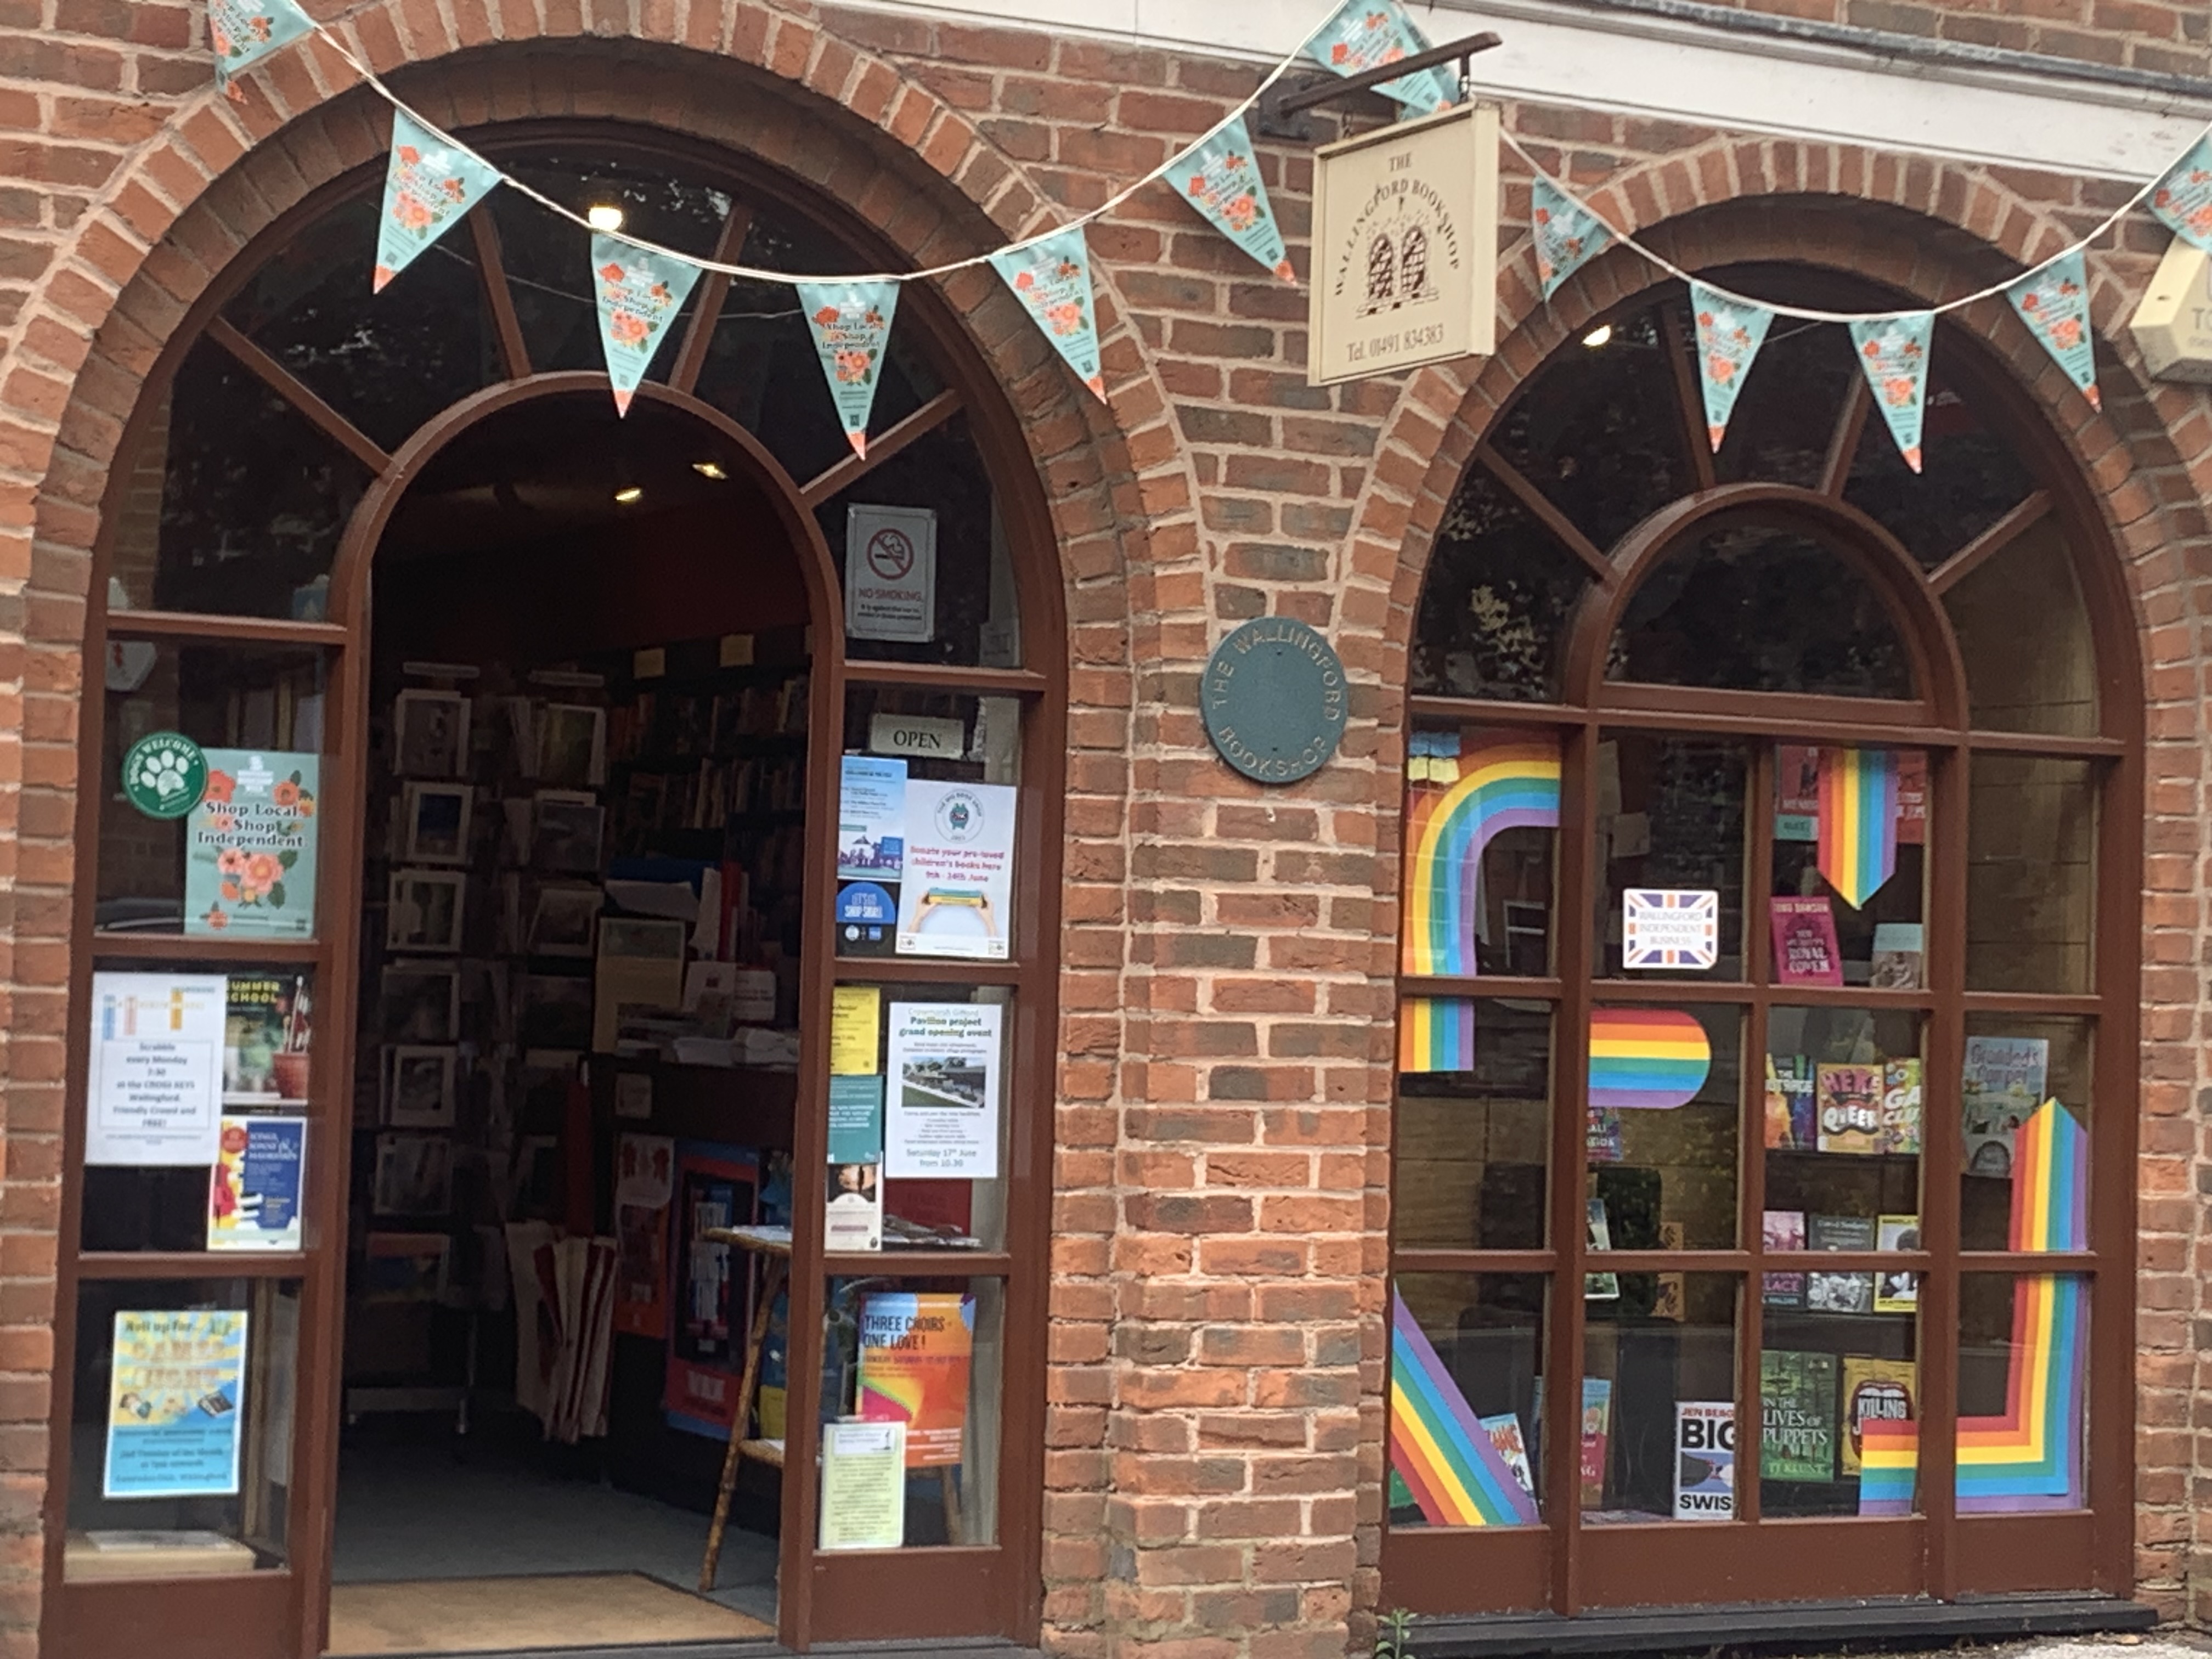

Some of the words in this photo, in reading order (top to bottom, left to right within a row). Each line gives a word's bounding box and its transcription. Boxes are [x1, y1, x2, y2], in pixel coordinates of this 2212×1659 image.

[1389, 153, 1412, 172] THE
[1335, 178, 1409, 296] WALLINGFORD
[1412, 179, 1459, 269] BOOKSHOP
[1369, 333, 1399, 358] 01491
[859, 588, 873, 599] NO
[875, 589, 922, 601] SMOKING
[1212, 661, 1234, 709] THE
[1233, 624, 1341, 721] WALLINGFORD
[893, 730, 943, 749] OPEN
[142, 738, 196, 760] WELCOME
[1218, 726, 1326, 777] BOOKSHOP
[206, 802, 249, 817] Shop
[256, 803, 297, 816] Local
[234, 819, 275, 833] Shop
[198, 831, 303, 847] Independent
[942, 849, 961, 857] your
[1639, 911, 1703, 922] WALLINGFORD
[1639, 923, 1702, 933] INDEPENDENT
[1650, 936, 1691, 945] BUSINESS
[949, 1018, 981, 1028] project
[899, 1027, 926, 1037] grand
[928, 1029, 964, 1038] opening
[967, 1029, 992, 1037] event
[152, 1056, 188, 1065] Monday
[1823, 1105, 1878, 1132] QUEER
[906, 1149, 941, 1158] Saturday
[865, 1316, 902, 1331] THREE
[905, 1316, 945, 1333] CHOIRS
[864, 1333, 887, 1348] ONE
[1763, 1397, 1775, 1407] IN
[1778, 1397, 1798, 1408] THE
[1858, 1397, 1907, 1420] KILLING
[1681, 1407, 1702, 1417] JEN
[1763, 1409, 1805, 1426] LIVES
[1681, 1419, 1734, 1451] BIG
[1763, 1427, 1827, 1446] PUPPETS
[1679, 1494, 1732, 1511] SWIS
